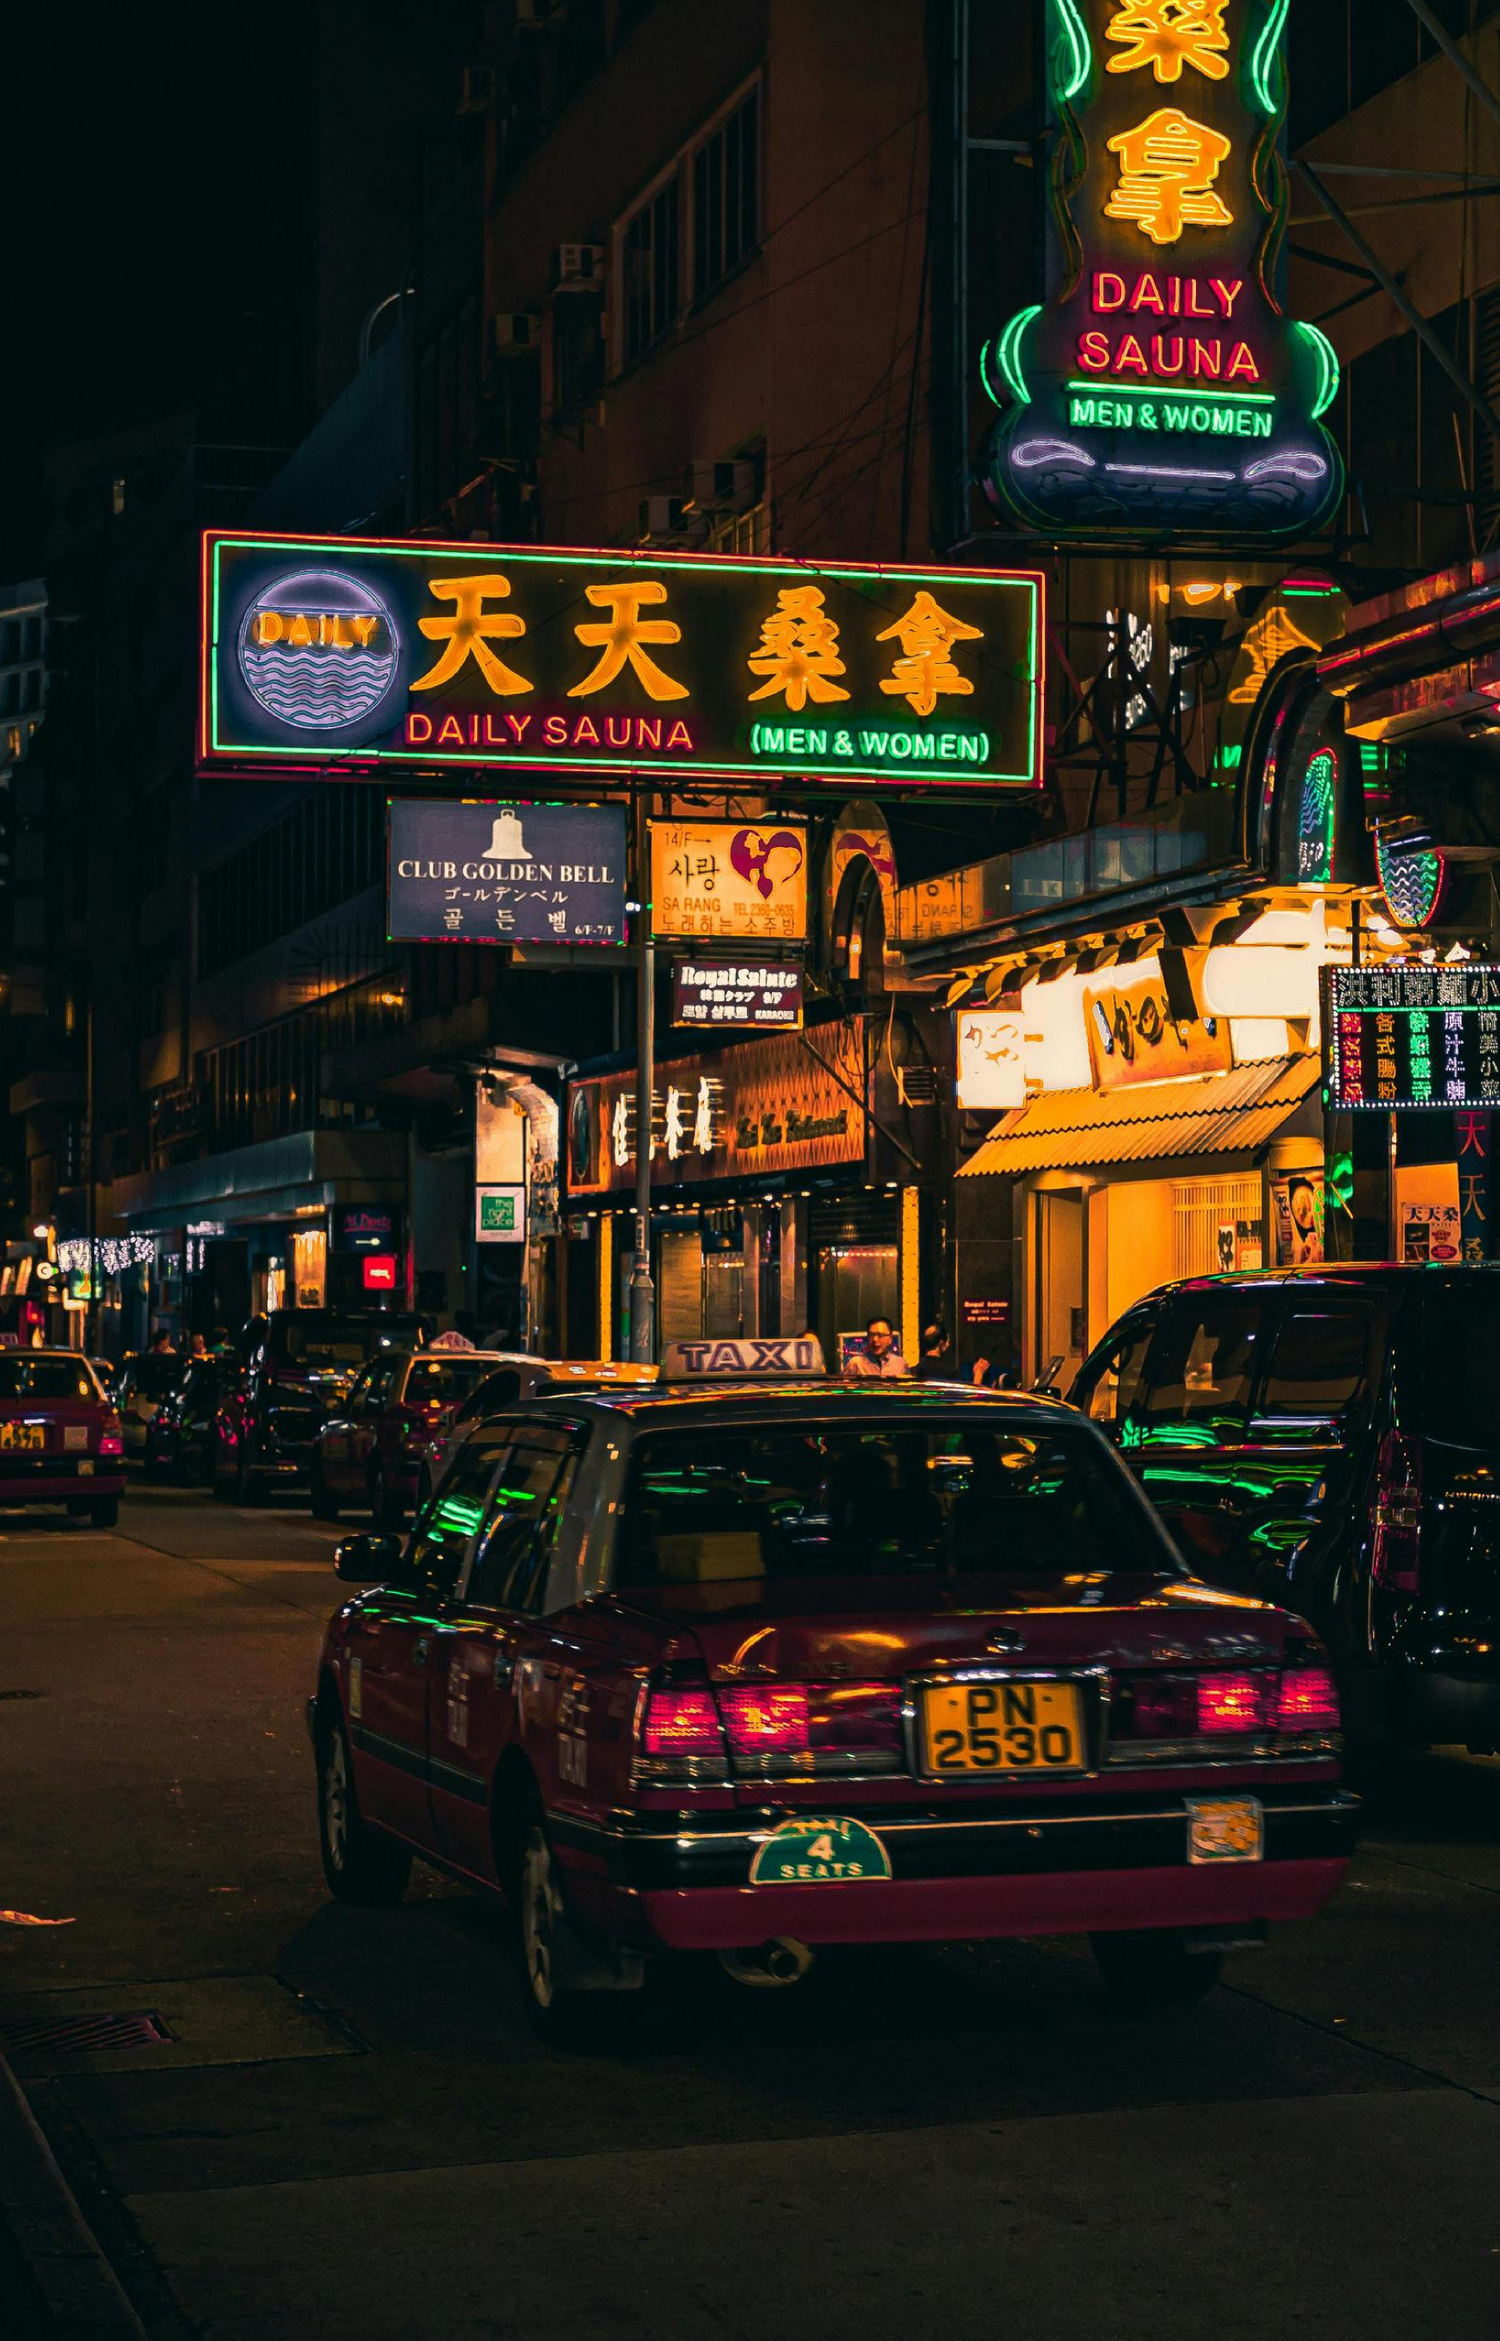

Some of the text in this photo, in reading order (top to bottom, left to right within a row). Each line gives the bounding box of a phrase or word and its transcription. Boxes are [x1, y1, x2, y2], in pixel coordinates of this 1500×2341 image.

[1092, 273, 1243, 320] DAILY
[1078, 330, 1261, 384] SAUNA
[1070, 398, 1273, 438] MEN & WOMEN
[257, 611, 378, 648] DAILY
[409, 574, 985, 716] 天天桑拿
[404, 713, 695, 750] DAILY SAUNA
[750, 723, 990, 763] (MEN & WOMEN)
[398, 860, 615, 884] CLUB GOLDEN BELL
[668, 853, 721, 892] 사랑
[445, 886, 569, 904] ゴールデンベル
[681, 966, 736, 988] Royal
[676, 1341, 815, 1373] TAXI
[966, 1687, 1035, 1726] PN
[934, 1723, 1070, 1769] 2530
[806, 1834, 835, 1861] 4
[780, 1862, 863, 1878] SEATS
